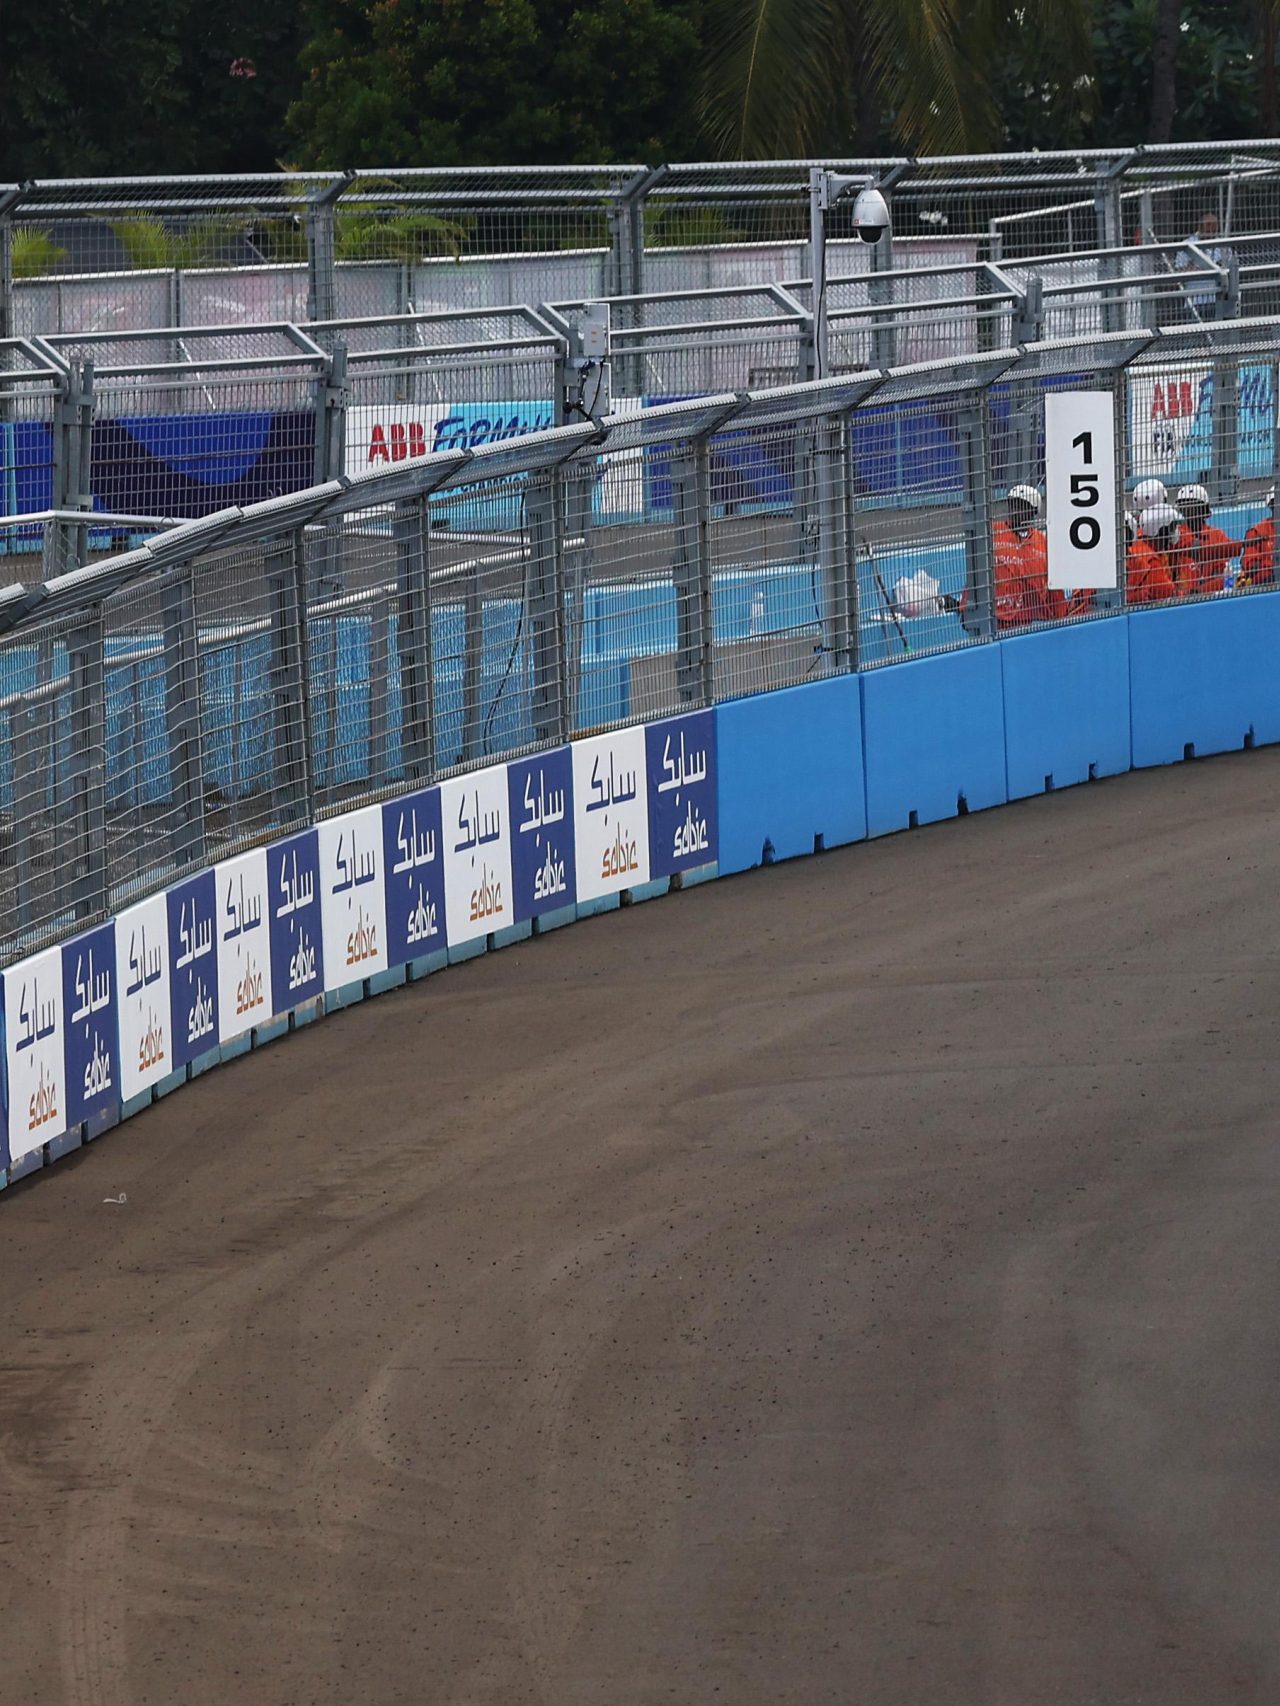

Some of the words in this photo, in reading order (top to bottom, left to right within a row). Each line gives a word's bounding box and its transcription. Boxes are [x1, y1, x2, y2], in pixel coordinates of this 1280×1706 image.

[368, 422, 425, 463] ABB
[1069, 431, 1101, 550] 150
[602, 822, 639, 878] sabic
[673, 800, 708, 858] sabic
[470, 863, 503, 921] sabic
[534, 842, 566, 900] sabic
[346, 904, 377, 966] sabic
[407, 883, 438, 944] sabic
[236, 951, 264, 1014] sabic
[289, 927, 316, 990] sabic
[138, 1006, 164, 1072] sabic
[188, 976, 214, 1044] sabic
[29, 1061, 57, 1130] sabic
[84, 1031, 111, 1099] sabic
